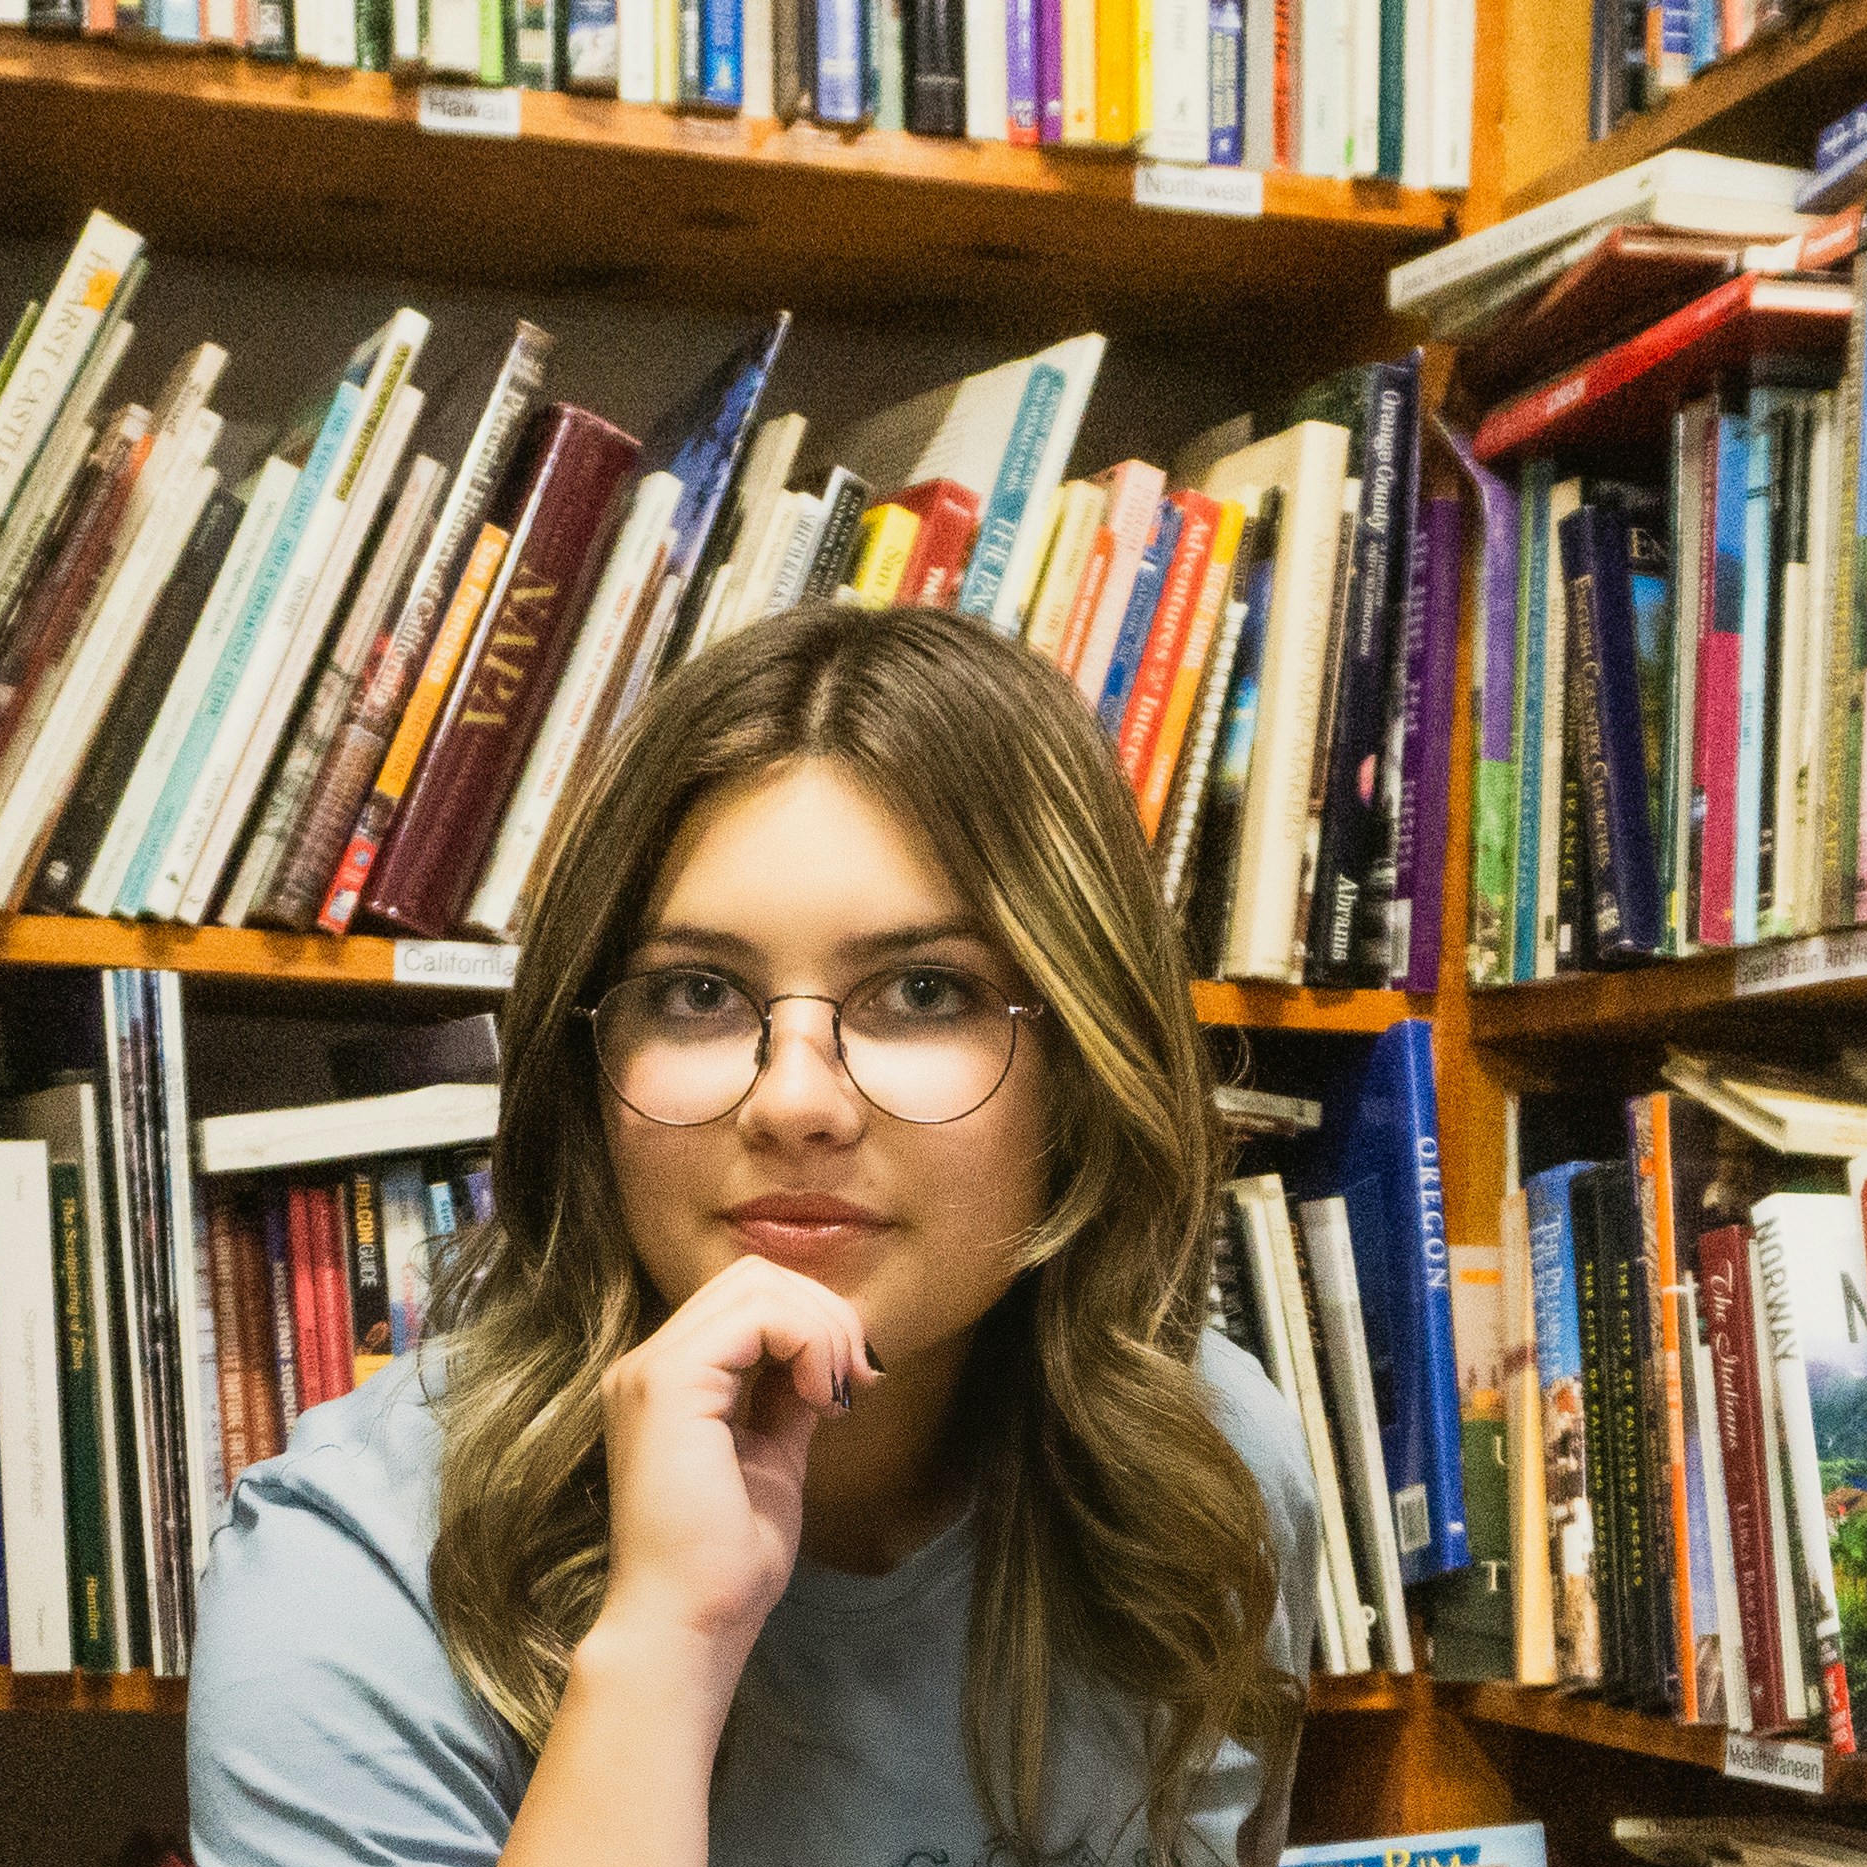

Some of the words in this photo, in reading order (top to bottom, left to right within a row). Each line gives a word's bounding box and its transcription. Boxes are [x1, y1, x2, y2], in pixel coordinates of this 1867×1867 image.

[430, 92, 511, 122] Hawaii
[1143, 173, 1254, 204] Northwest
[37, 248, 111, 364] HEARST
[467, 385, 528, 486] Pictorial
[1371, 387, 1402, 461] Orange
[430, 481, 487, 569] History
[1363, 463, 1395, 534] County
[467, 537, 504, 584] San
[985, 514, 1019, 567] THE
[420, 566, 451, 600] of
[1150, 511, 1212, 664] Adventures
[369, 594, 439, 711] California
[423, 581, 485, 688] Francisco
[462, 565, 557, 724] NAPA
[1300, 612, 1322, 665] AND
[535, 728, 575, 802] CALIFORNIA
[1556, 779, 1582, 892] FRANCE
[1587, 759, 1612, 869] CHURCHES
[1329, 871, 1360, 962] Abrams
[403, 948, 515, 978] California
[60, 1196, 79, 1227] The
[349, 1181, 377, 1244] FALCON
[1415, 1135, 1450, 1289] OREGON
[353, 1242, 380, 1288] GUIDE
[1583, 1260, 1596, 1299] THE
[1617, 1260, 1631, 1298] THE
[1707, 1259, 1739, 1324] The
[1743, 1216, 1807, 1366] NORWAY
[271, 1260, 294, 1359] MOUNTAIN
[1619, 1306, 1634, 1357] CITY
[69, 1337, 89, 1370] Zion
[1622, 1367, 1636, 1393] OF
[221, 1371, 245, 1428] NATURE
[1713, 1328, 1750, 1451] Italians
[1623, 1403, 1641, 1493] FALLING
[26, 1462, 47, 1518] Places
[1628, 1504, 1645, 1587] ANGELS
[83, 1574, 105, 1640] Hamilton
